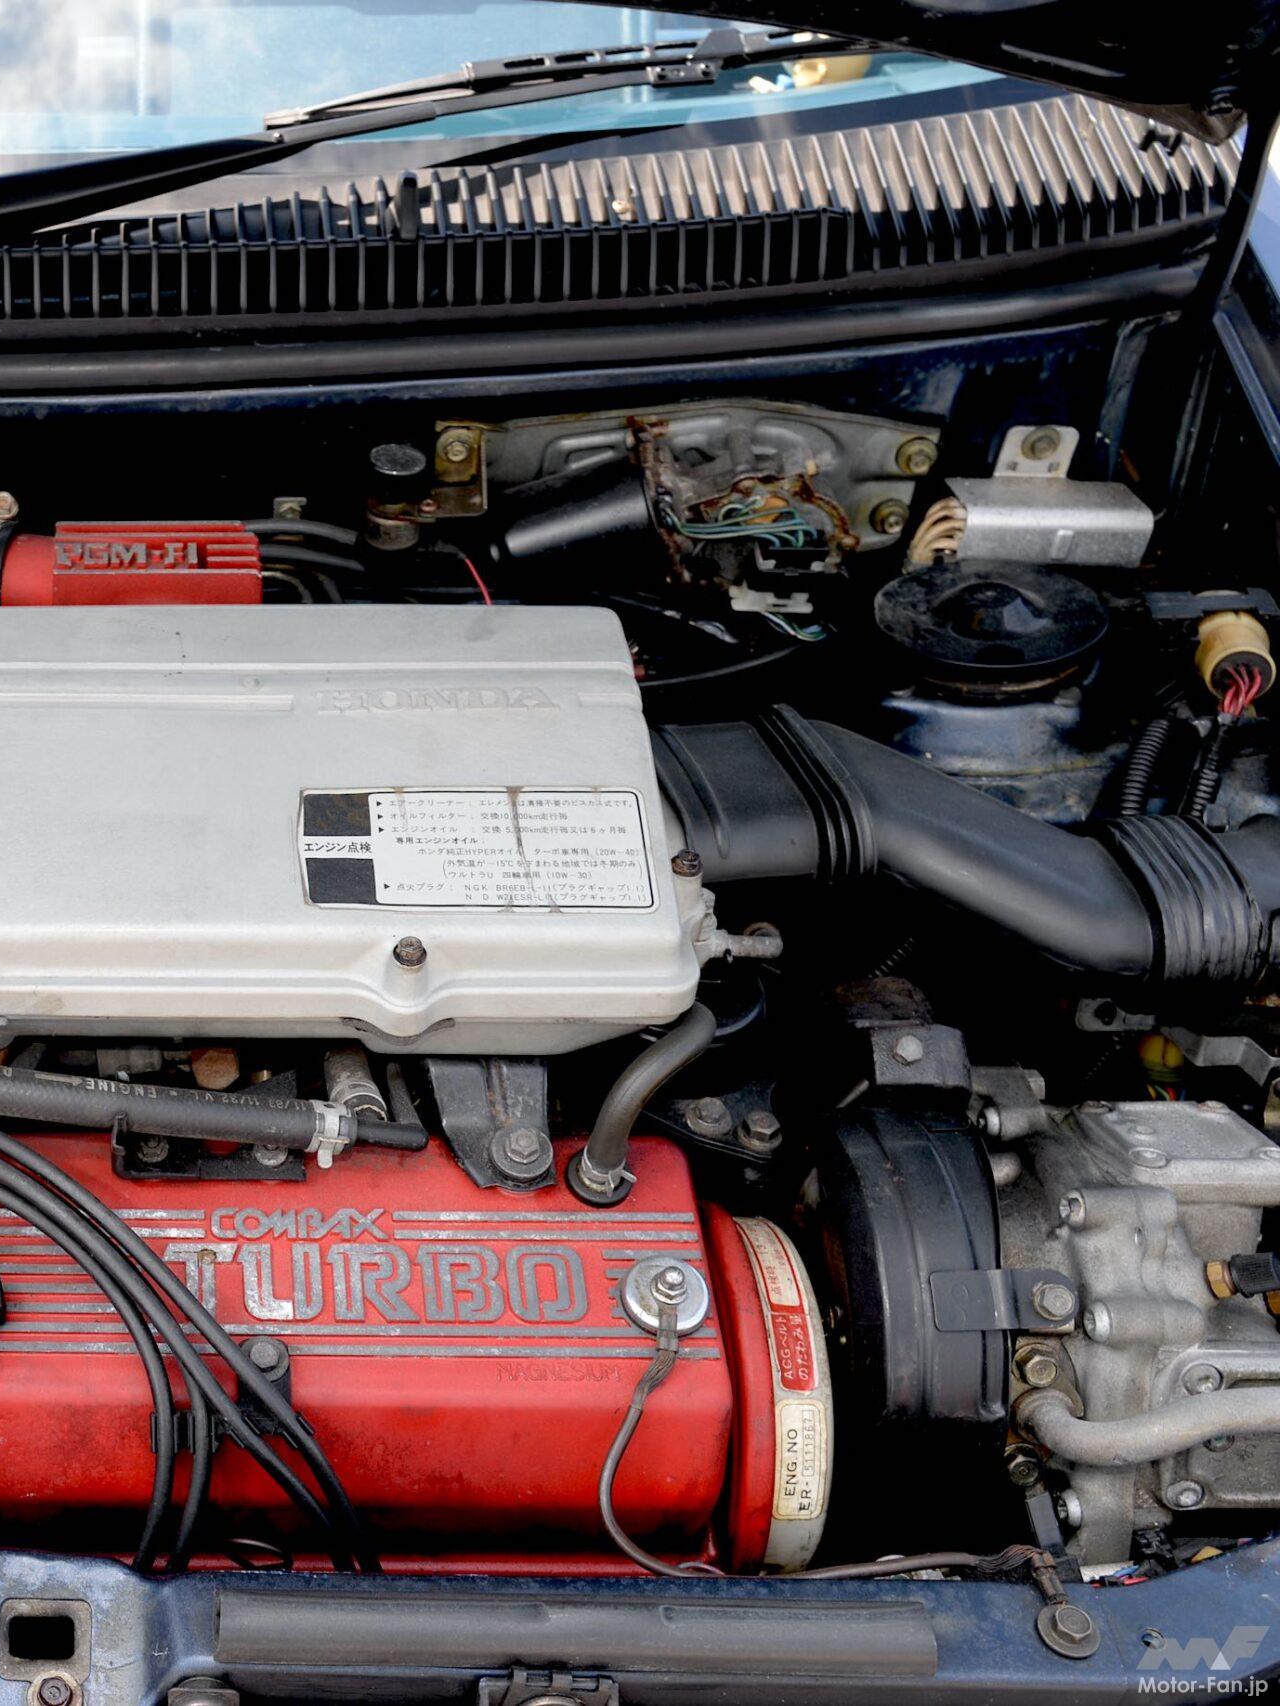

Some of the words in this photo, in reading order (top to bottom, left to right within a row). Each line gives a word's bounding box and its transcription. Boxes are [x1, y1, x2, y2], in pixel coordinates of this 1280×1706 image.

[55, 541, 199, 568] PGM-FI
[315, 686, 561, 713] HONDA
[304, 841, 373, 853] エンジン点検
[84, 1077, 158, 1099] ENGINE
[210, 1206, 390, 1240] COMBAX
[162, 1242, 591, 1324] TURBO
[495, 1361, 622, 1384] MAGNESIUM
